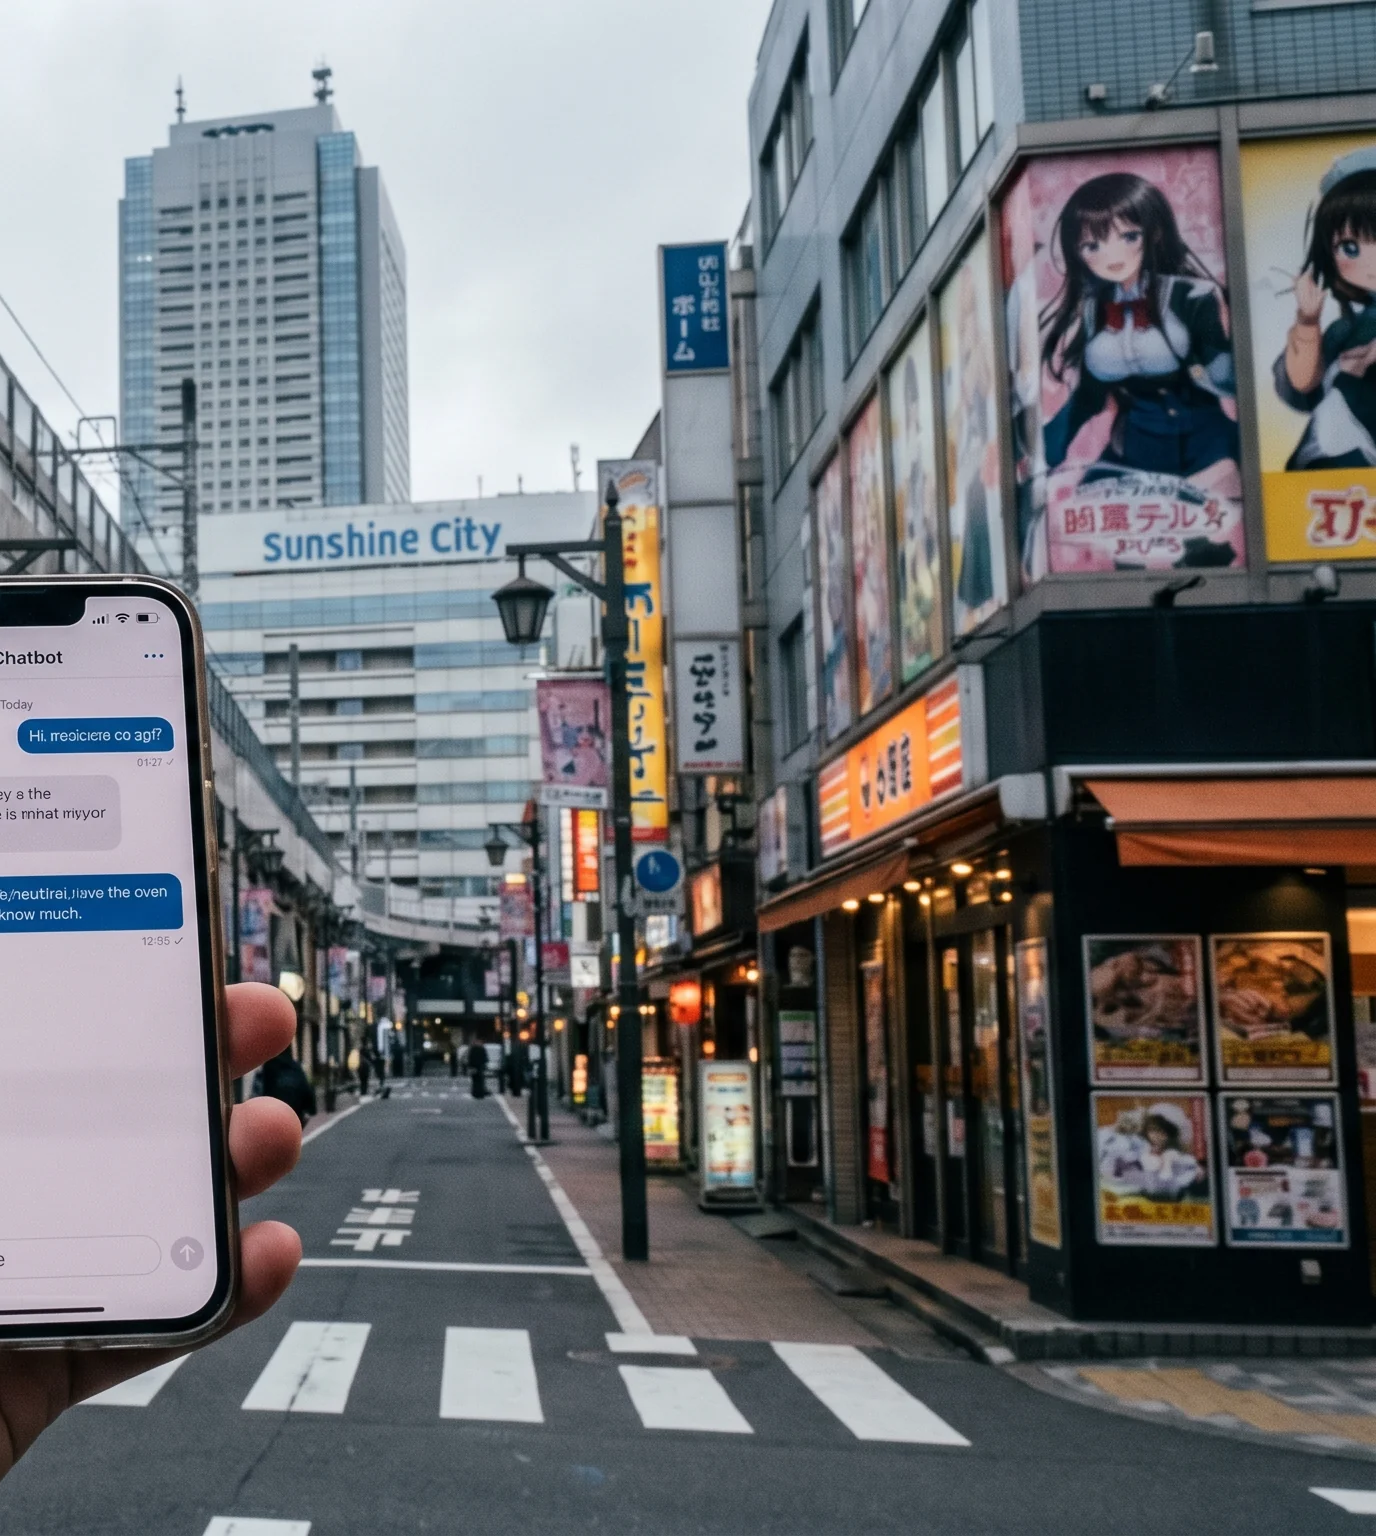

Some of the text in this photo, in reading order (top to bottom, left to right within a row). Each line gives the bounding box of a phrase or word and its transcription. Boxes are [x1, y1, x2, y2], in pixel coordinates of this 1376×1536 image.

[263, 516, 501, 563] Sunshine City
[0, 699, 34, 712] Today
[114, 730, 132, 742] co
[136, 757, 163, 768] 01:27
[28, 787, 52, 800] the
[6, 807, 17, 820] is
[107, 886, 131, 899] the
[134, 886, 168, 898] oven
[39, 906, 83, 920] much.
